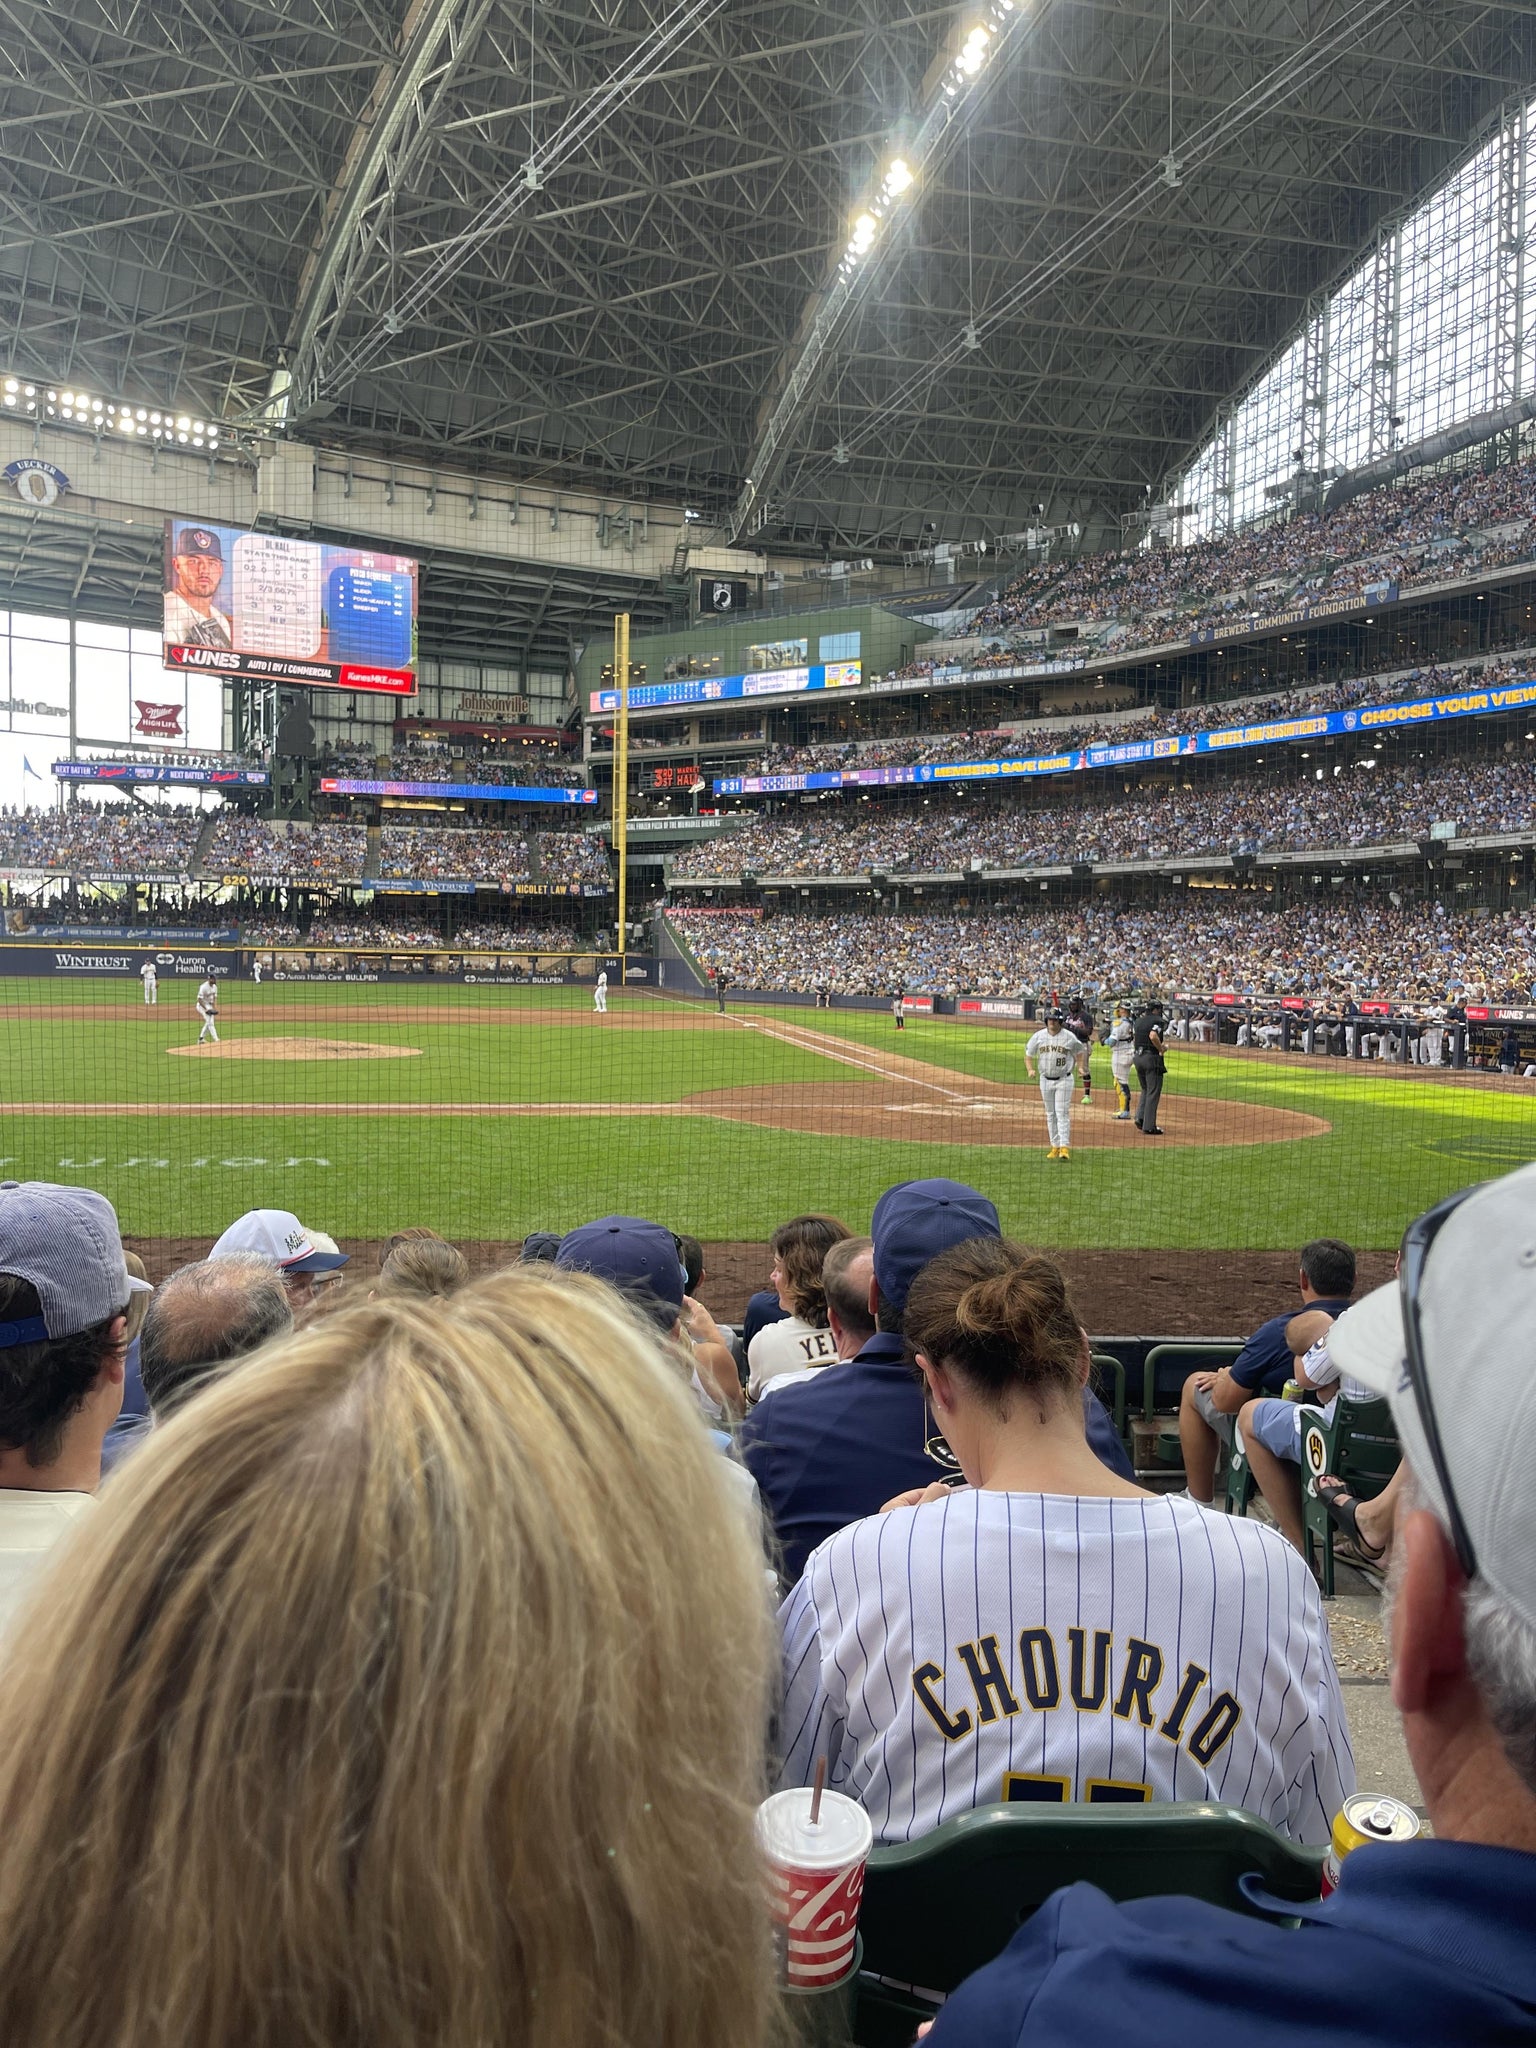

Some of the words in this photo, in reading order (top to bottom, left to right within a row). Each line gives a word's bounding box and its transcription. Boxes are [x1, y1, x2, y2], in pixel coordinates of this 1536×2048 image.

[16, 460, 57, 475] UECKER
[244, 549, 270, 558] STATS
[289, 556, 311, 564] GAME
[1214, 623, 1251, 640] BREWERS
[1253, 610, 1306, 631] COMMUNITY
[1308, 596, 1367, 619] FOUNDATION
[183, 648, 240, 669] KUNES
[247, 660, 267, 671] AUTO
[288, 665, 333, 679] COMMERCIAL
[458, 692, 529, 713] Johnsonville
[1360, 703, 1434, 727] CHOOSE
[1435, 694, 1489, 715] YOUR
[1491, 685, 1536, 707] VIEW
[145, 707, 173, 719] Miller
[142, 719, 160, 727] HIGH
[1109, 748, 1127, 761] PLANS
[1126, 745, 1144, 759] START
[55, 765, 70, 774] NEXT
[70, 766, 91, 775] BATTER
[676, 766, 700, 774] MARKET
[934, 762, 1000, 778] MEMBERS
[1000, 757, 1037, 773] SAVE
[1037, 755, 1071, 771] MORE
[721, 781, 739, 792] 3:31
[90, 872, 110, 881] GREAT
[111, 873, 133, 882] TASTE.
[135, 874, 144, 882] 96
[145, 874, 178, 883] CALORIES.
[223, 875, 248, 886] 620
[250, 876, 290, 887] WTMJ
[421, 881, 470, 892] WINTRUST
[515, 884, 548, 895] NICOLET
[550, 885, 567, 895] LAW
[55, 953, 130, 967] WINTRUST
[176, 955, 206, 965] Aurora
[175, 964, 205, 974] Health
[207, 965, 229, 974] Care
[286, 973, 306, 981] Aurora
[307, 973, 327, 981] Health
[516, 976, 529, 984] Care
[1498, 1009, 1524, 1020] KUNES
[912, 1626, 1244, 1768] CHOURIO
